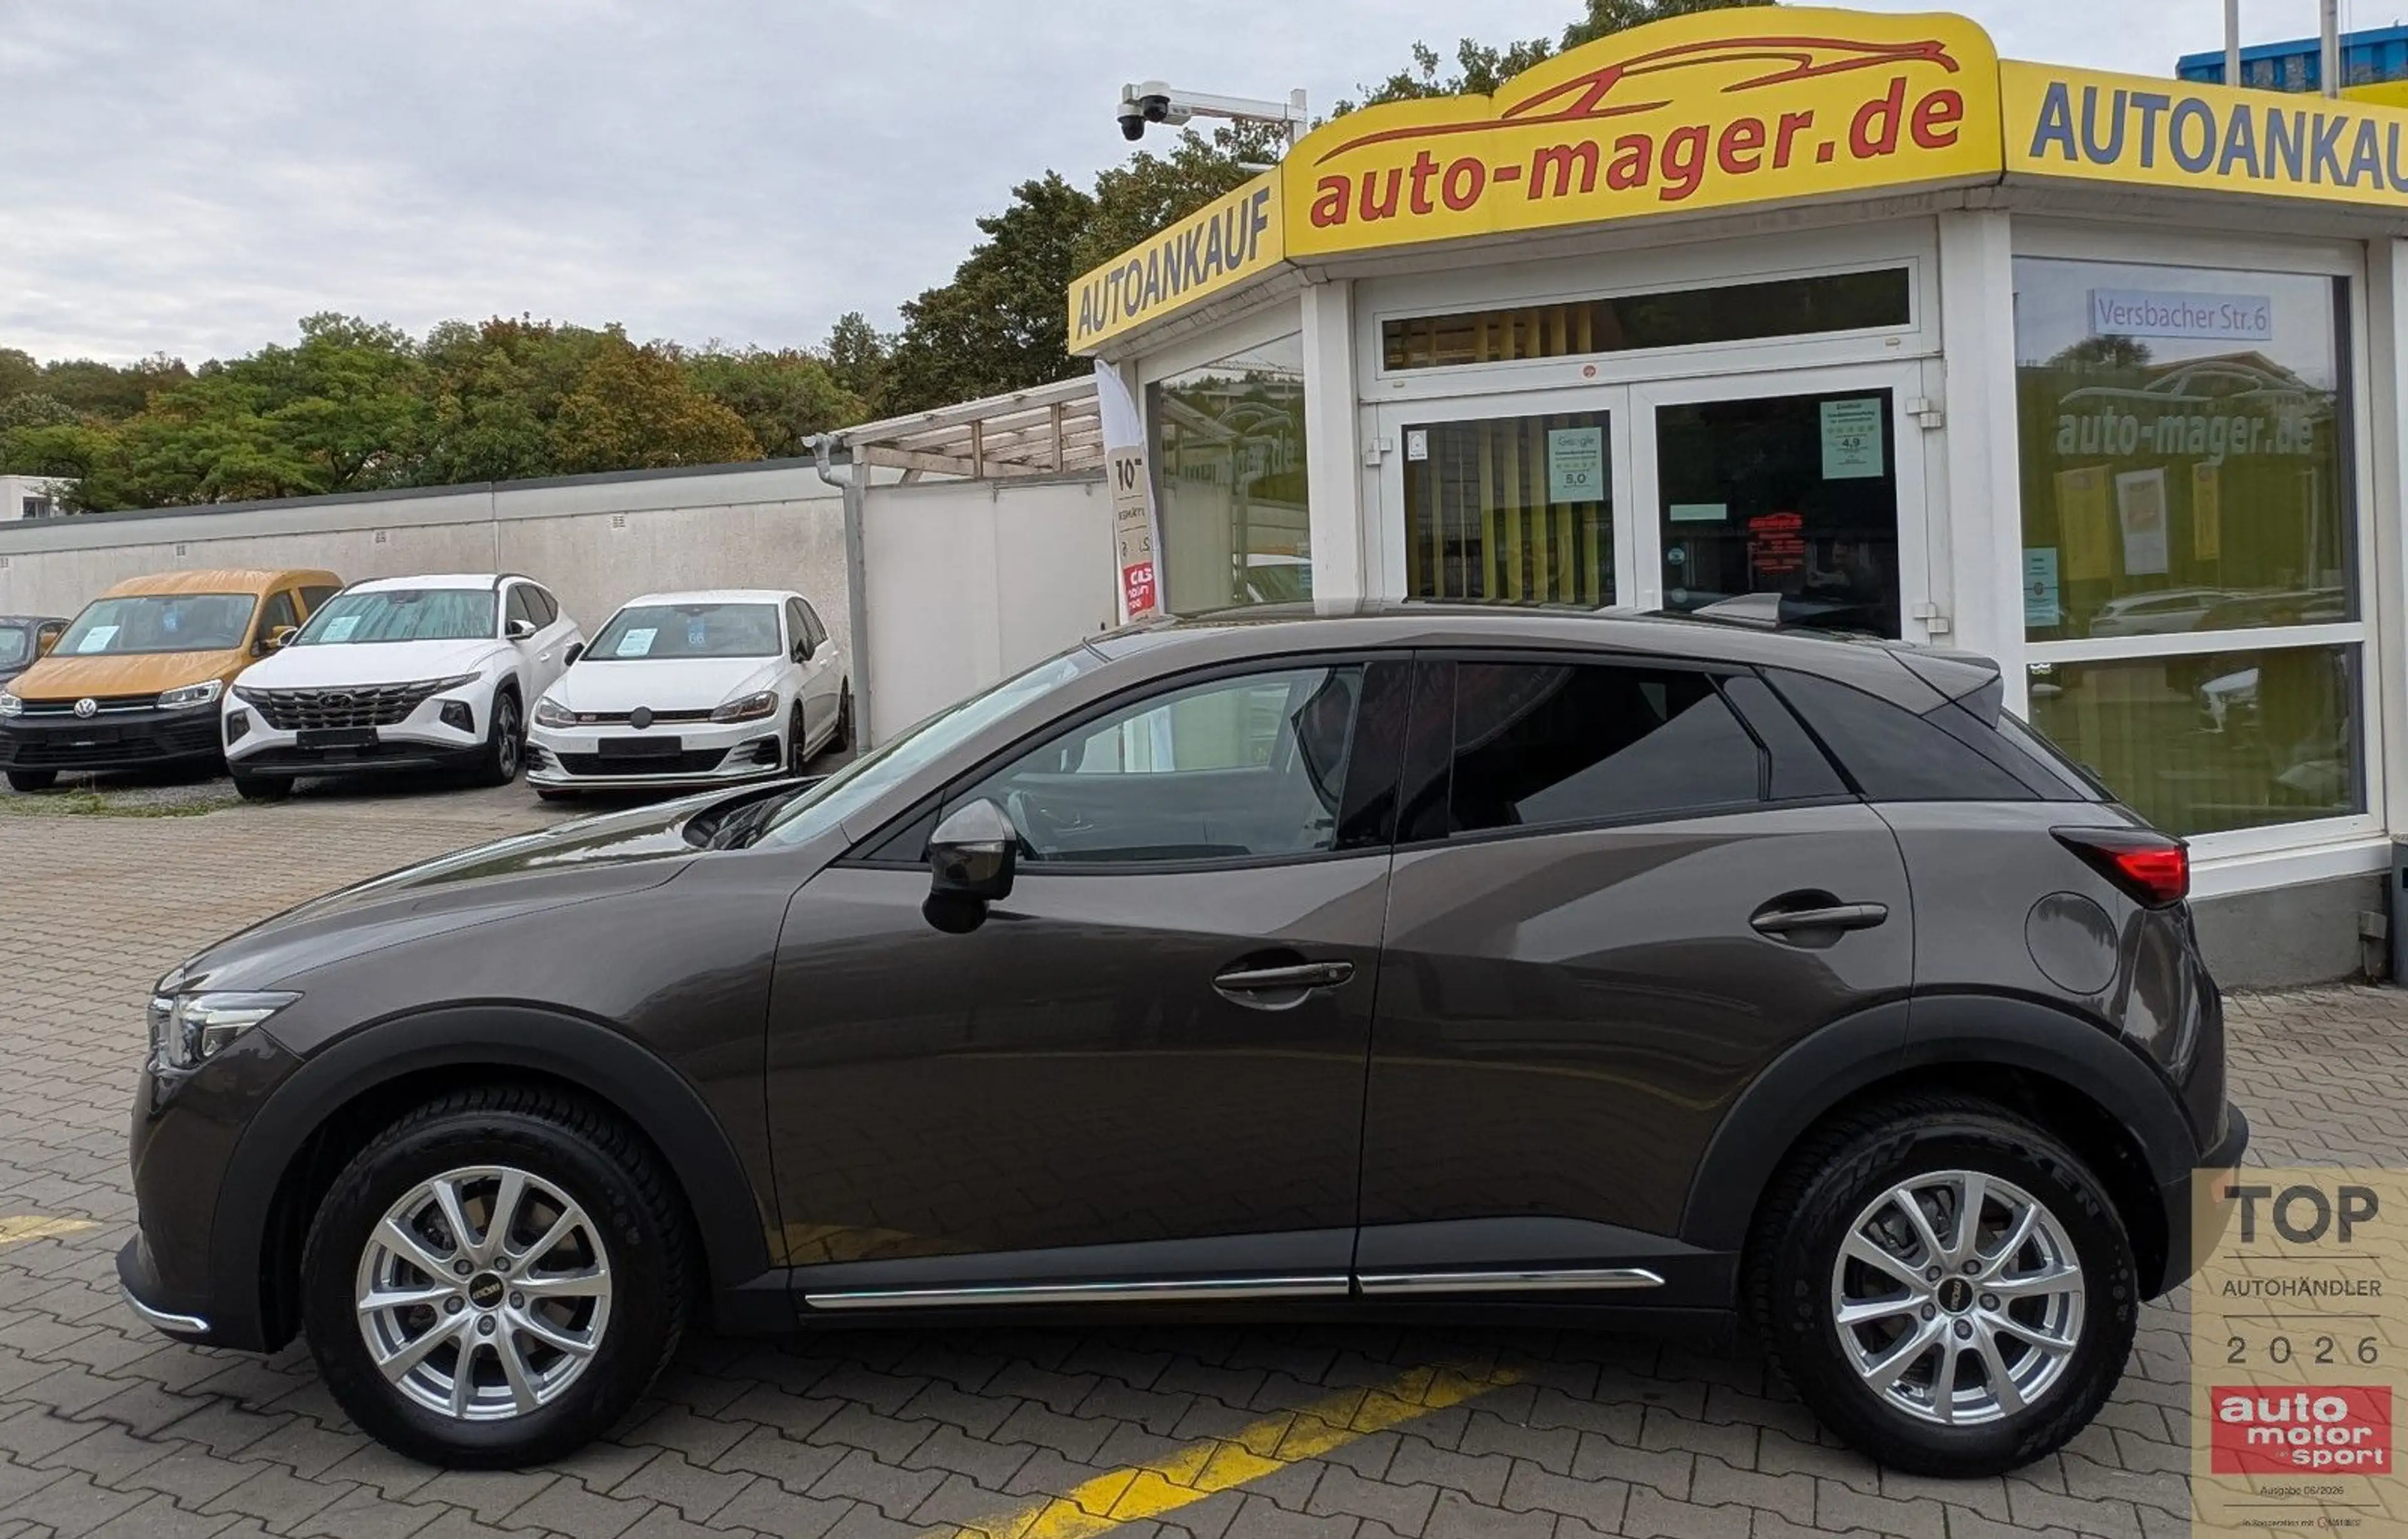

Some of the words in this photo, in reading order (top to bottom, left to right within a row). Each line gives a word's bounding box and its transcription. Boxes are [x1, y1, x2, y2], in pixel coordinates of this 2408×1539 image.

[1311, 76, 1963, 228] auto-mager.de
[1077, 186, 1270, 340] AUTOANKAUF
[2098, 297, 2215, 330] Versbacher
[2056, 405, 2313, 467] auto-mager.de
